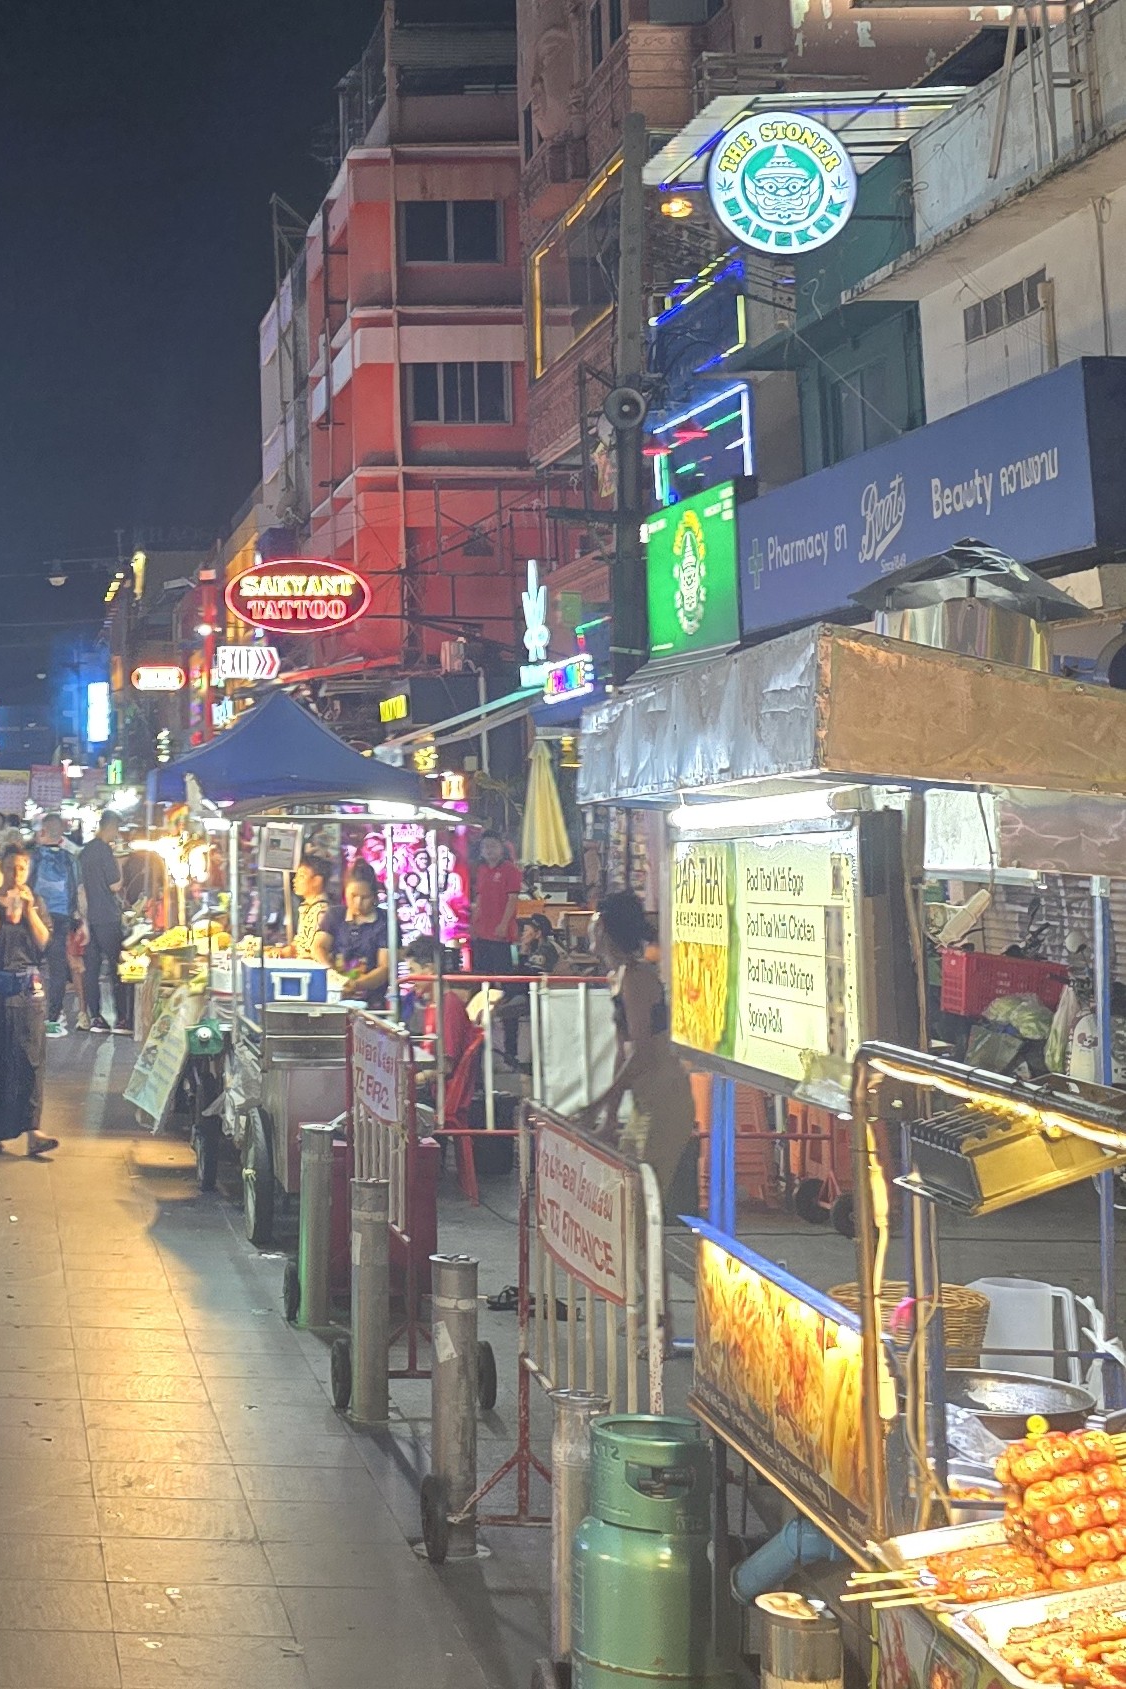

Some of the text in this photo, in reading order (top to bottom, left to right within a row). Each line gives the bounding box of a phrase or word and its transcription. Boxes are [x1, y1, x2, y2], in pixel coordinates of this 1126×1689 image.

[718, 121, 841, 173] THE STONER
[723, 195, 847, 246] BANGKOK
[767, 447, 1058, 571] Pharmacy ยา Boots Beauty ความงาม
[239, 574, 356, 597] SAKYANT
[246, 599, 347, 620] TATTOO
[220, 649, 252, 675] EXIT
[675, 856, 724, 906] PAD THAI
[746, 867, 804, 897] Pad Thai With Eggs
[746, 912, 759, 937] Pad
[760, 912, 773, 938] Thai
[773, 914, 788, 939] With
[788, 914, 816, 942] Chicken
[747, 957, 760, 982] Pad
[761, 958, 774, 984] Thai
[774, 961, 789, 987] With
[748, 1003, 783, 1034] Spring Rolls
